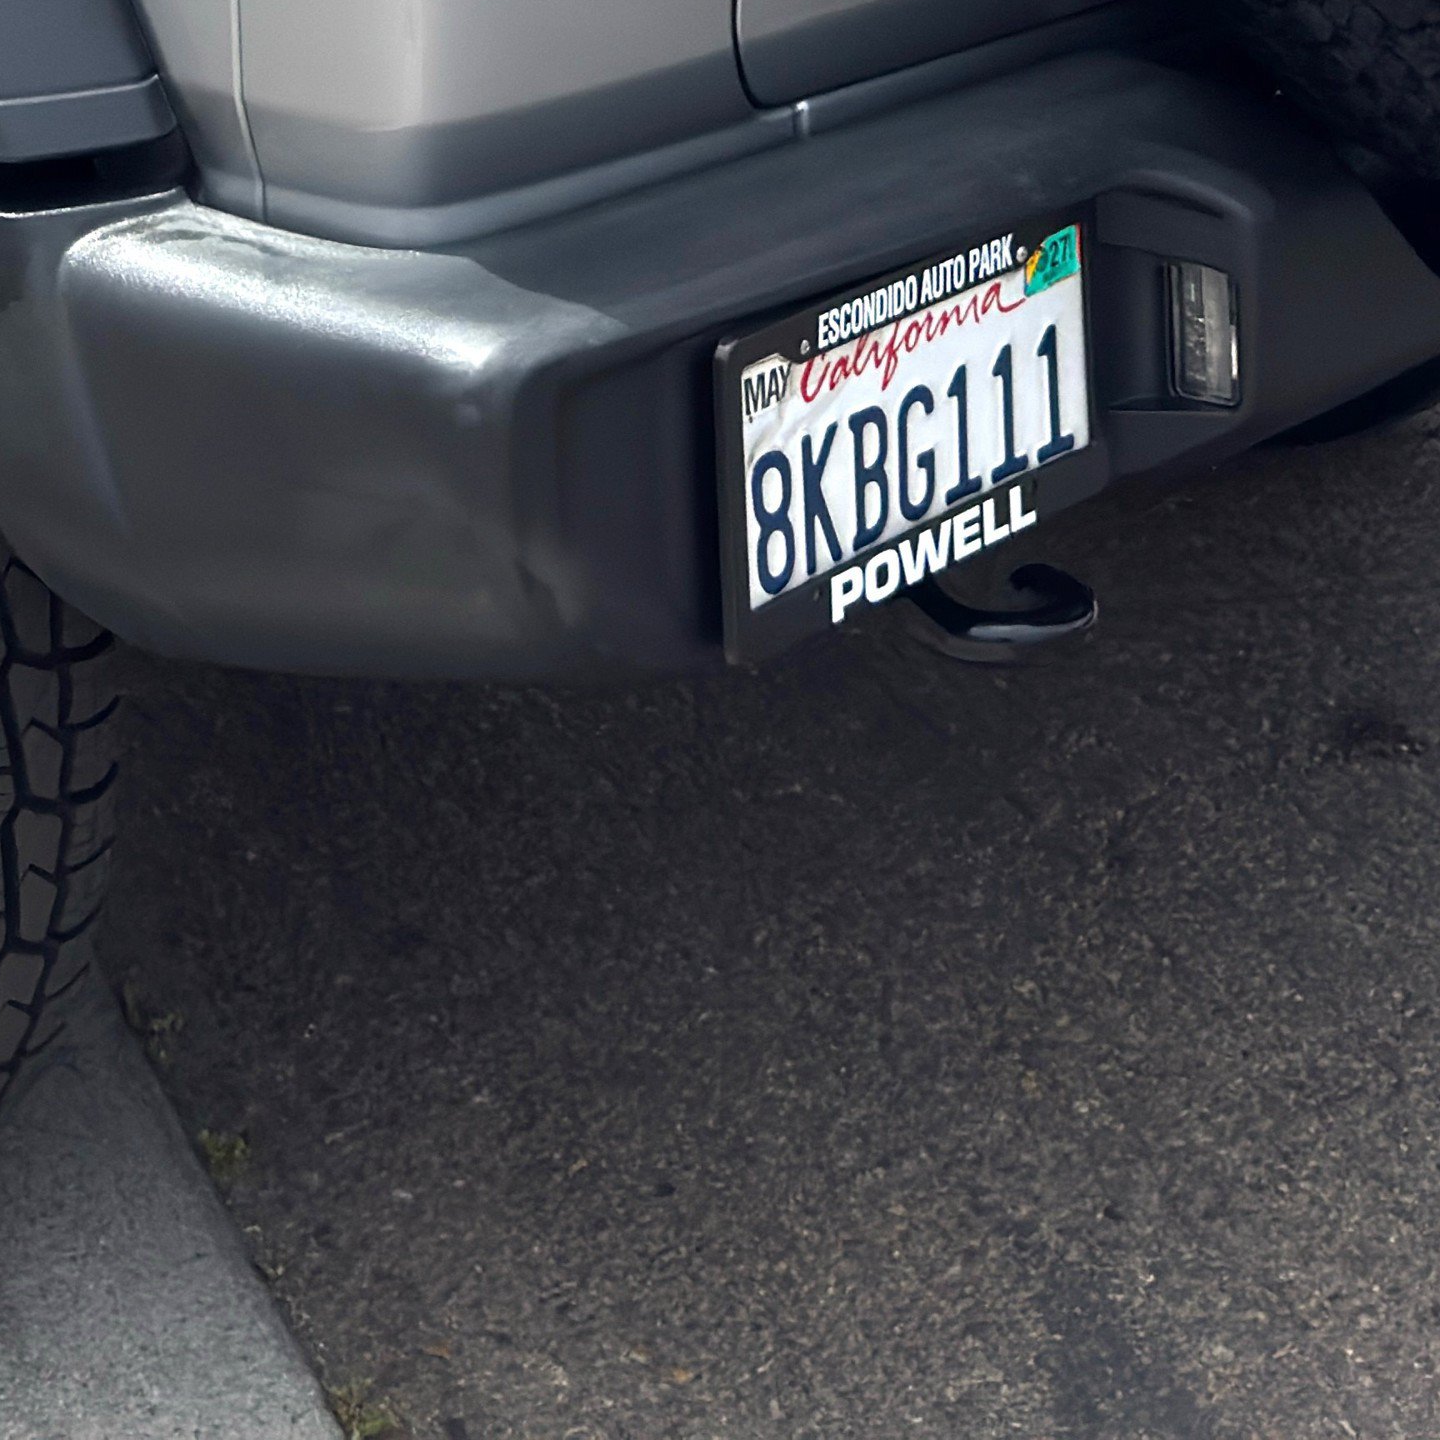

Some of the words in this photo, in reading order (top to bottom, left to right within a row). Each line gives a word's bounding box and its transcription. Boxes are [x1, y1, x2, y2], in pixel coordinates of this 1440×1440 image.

[800, 280, 1026, 404] California
[817, 276, 919, 348] ESCONDIDO
[921, 255, 967, 304] AUTO
[969, 232, 1015, 284] PARK
[744, 365, 789, 417] MAY
[750, 323, 1075, 596] 8KBG111
[829, 484, 1037, 624] POWELL
